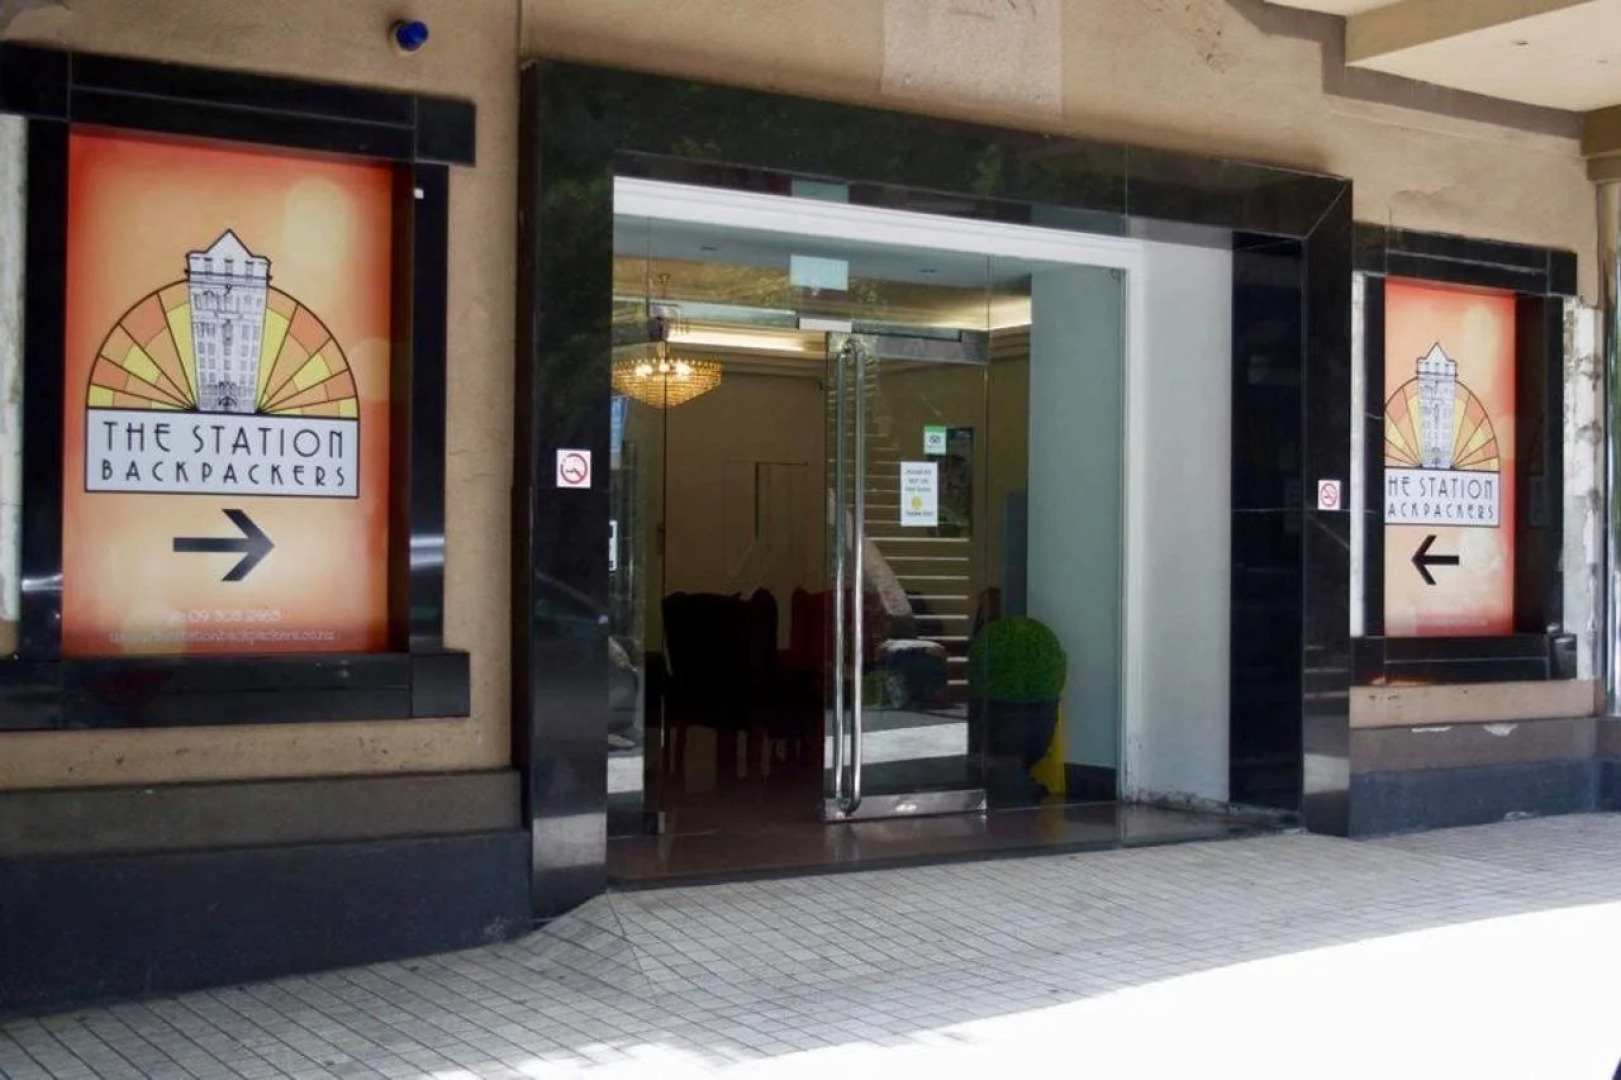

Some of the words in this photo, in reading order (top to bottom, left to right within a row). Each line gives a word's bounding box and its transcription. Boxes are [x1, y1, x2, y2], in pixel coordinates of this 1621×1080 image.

[103, 421, 171, 452] THE
[193, 425, 343, 458] STATION
[102, 459, 345, 487] BACKPACKERS
[1388, 475, 1411, 497] HE
[1419, 477, 1493, 500] STATION
[1388, 502, 1494, 519] ACKPACKERS
